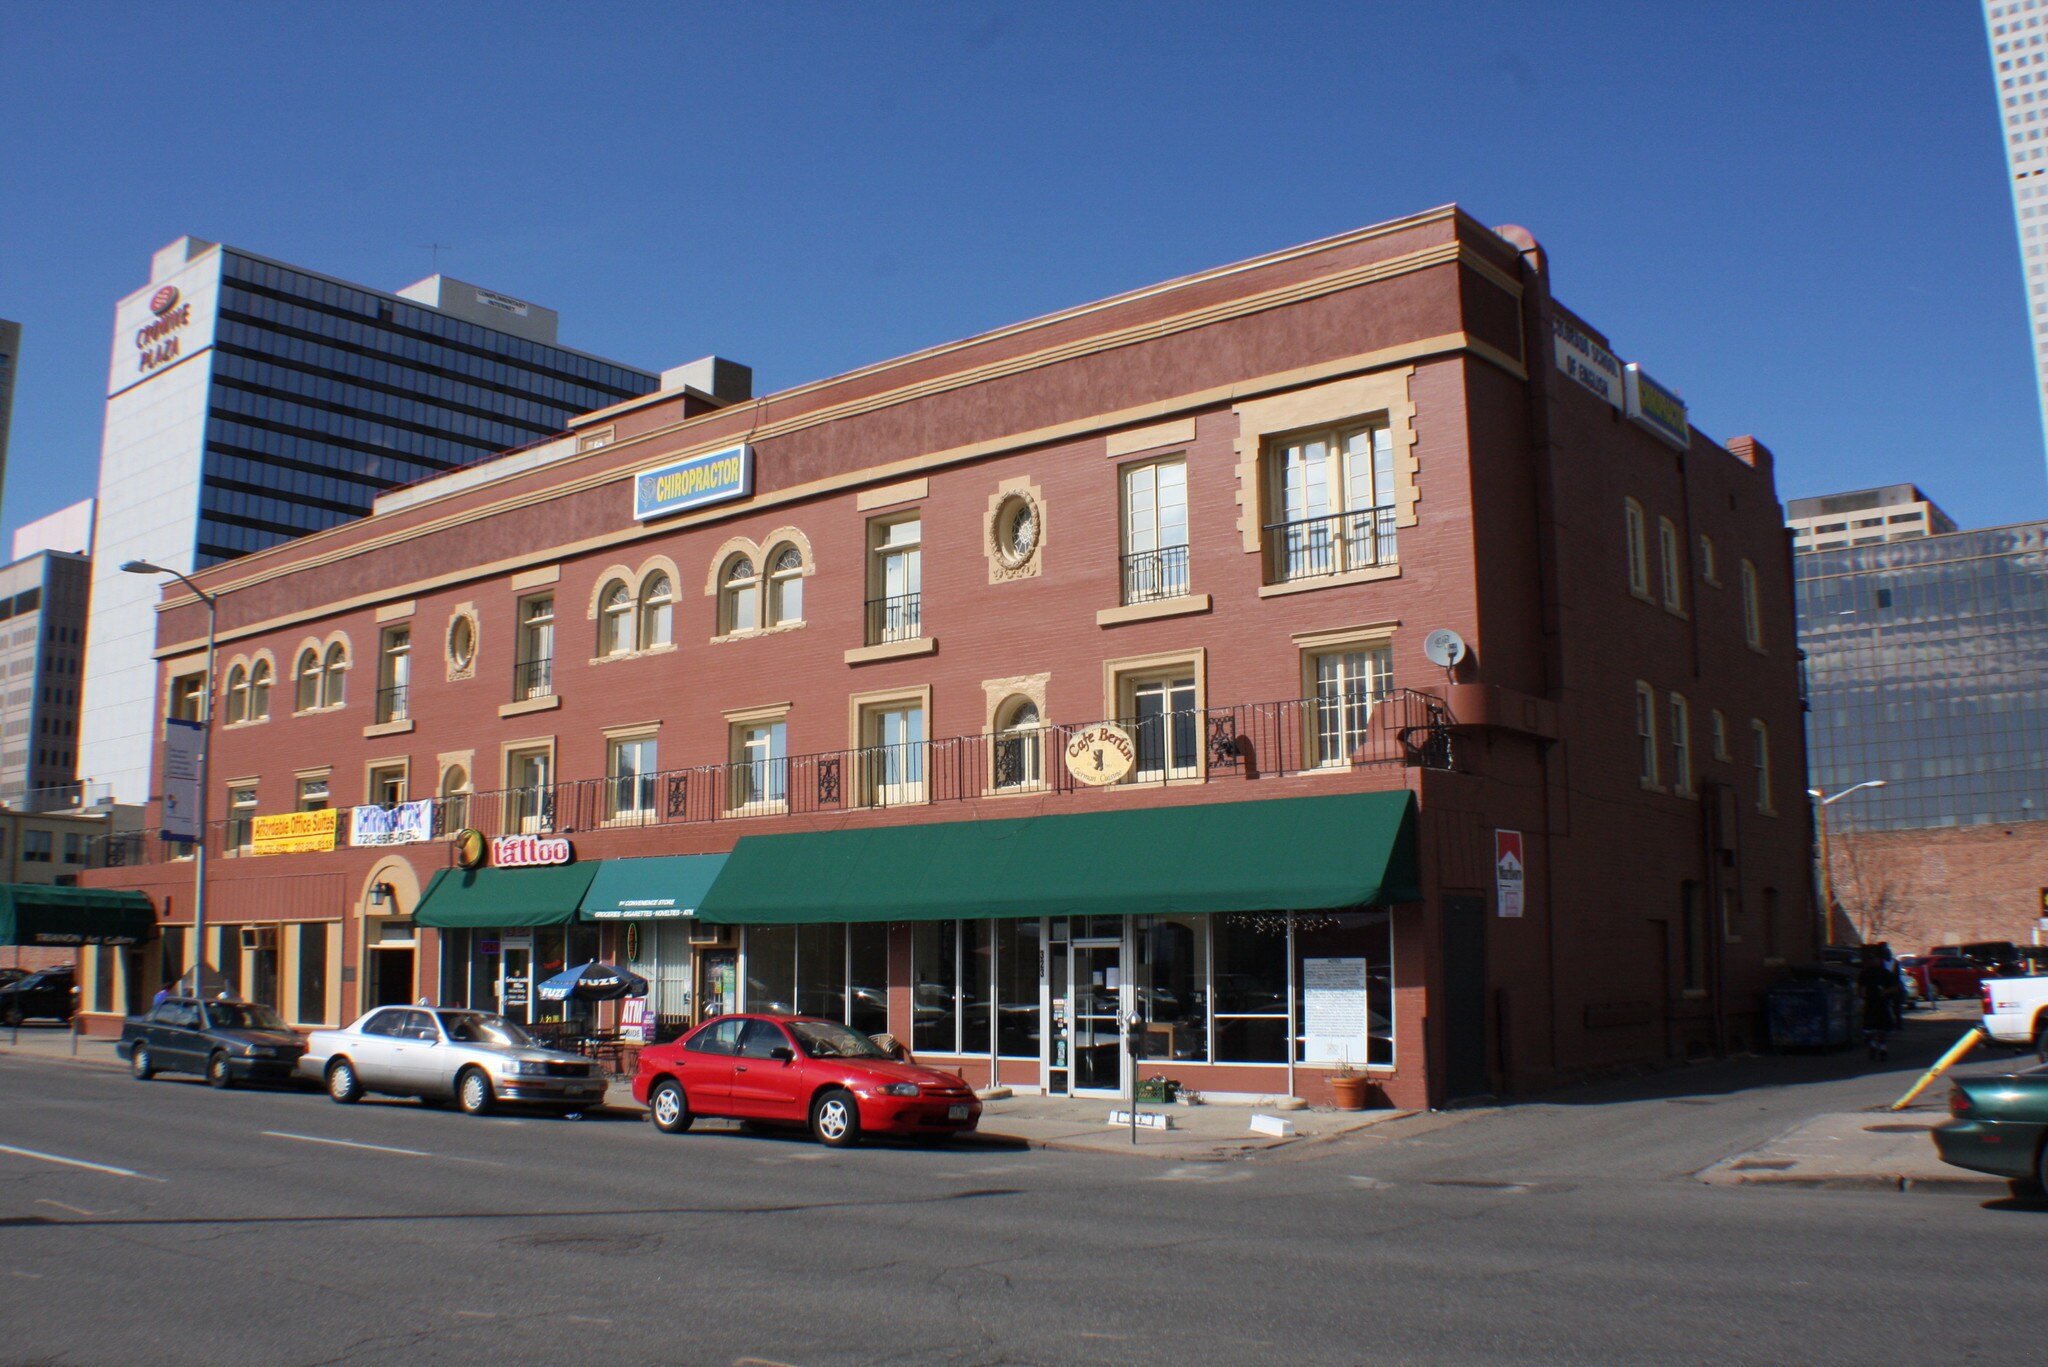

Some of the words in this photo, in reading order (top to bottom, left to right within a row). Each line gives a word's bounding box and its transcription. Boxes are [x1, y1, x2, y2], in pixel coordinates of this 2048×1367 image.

[136, 303, 191, 349] CROWNE
[139, 336, 180, 372] PLAZA
[1591, 343, 1619, 378] SCHOOL
[1567, 354, 1577, 377] OF
[1579, 362, 1609, 399] ENGLISH
[656, 457, 739, 502] CHIROPRACTOR
[1069, 733, 1095, 757] Cafe
[1098, 728, 1133, 762] Berlin
[254, 818, 289, 838] Affordable
[291, 815, 311, 834] Office
[312, 812, 335, 831] Suites
[494, 838, 568, 865] tattoo
[594, 910, 621, 918] GROCERIES
[623, 910, 653, 918] CIGARETTES
[655, 909, 681, 917] NOVELTIES
[625, 899, 658, 907] CONVENIENCE
[658, 898, 676, 906] STORE
[541, 987, 570, 999] FUZE
[579, 976, 619, 986] FUZE
[622, 999, 644, 1024] ATM
